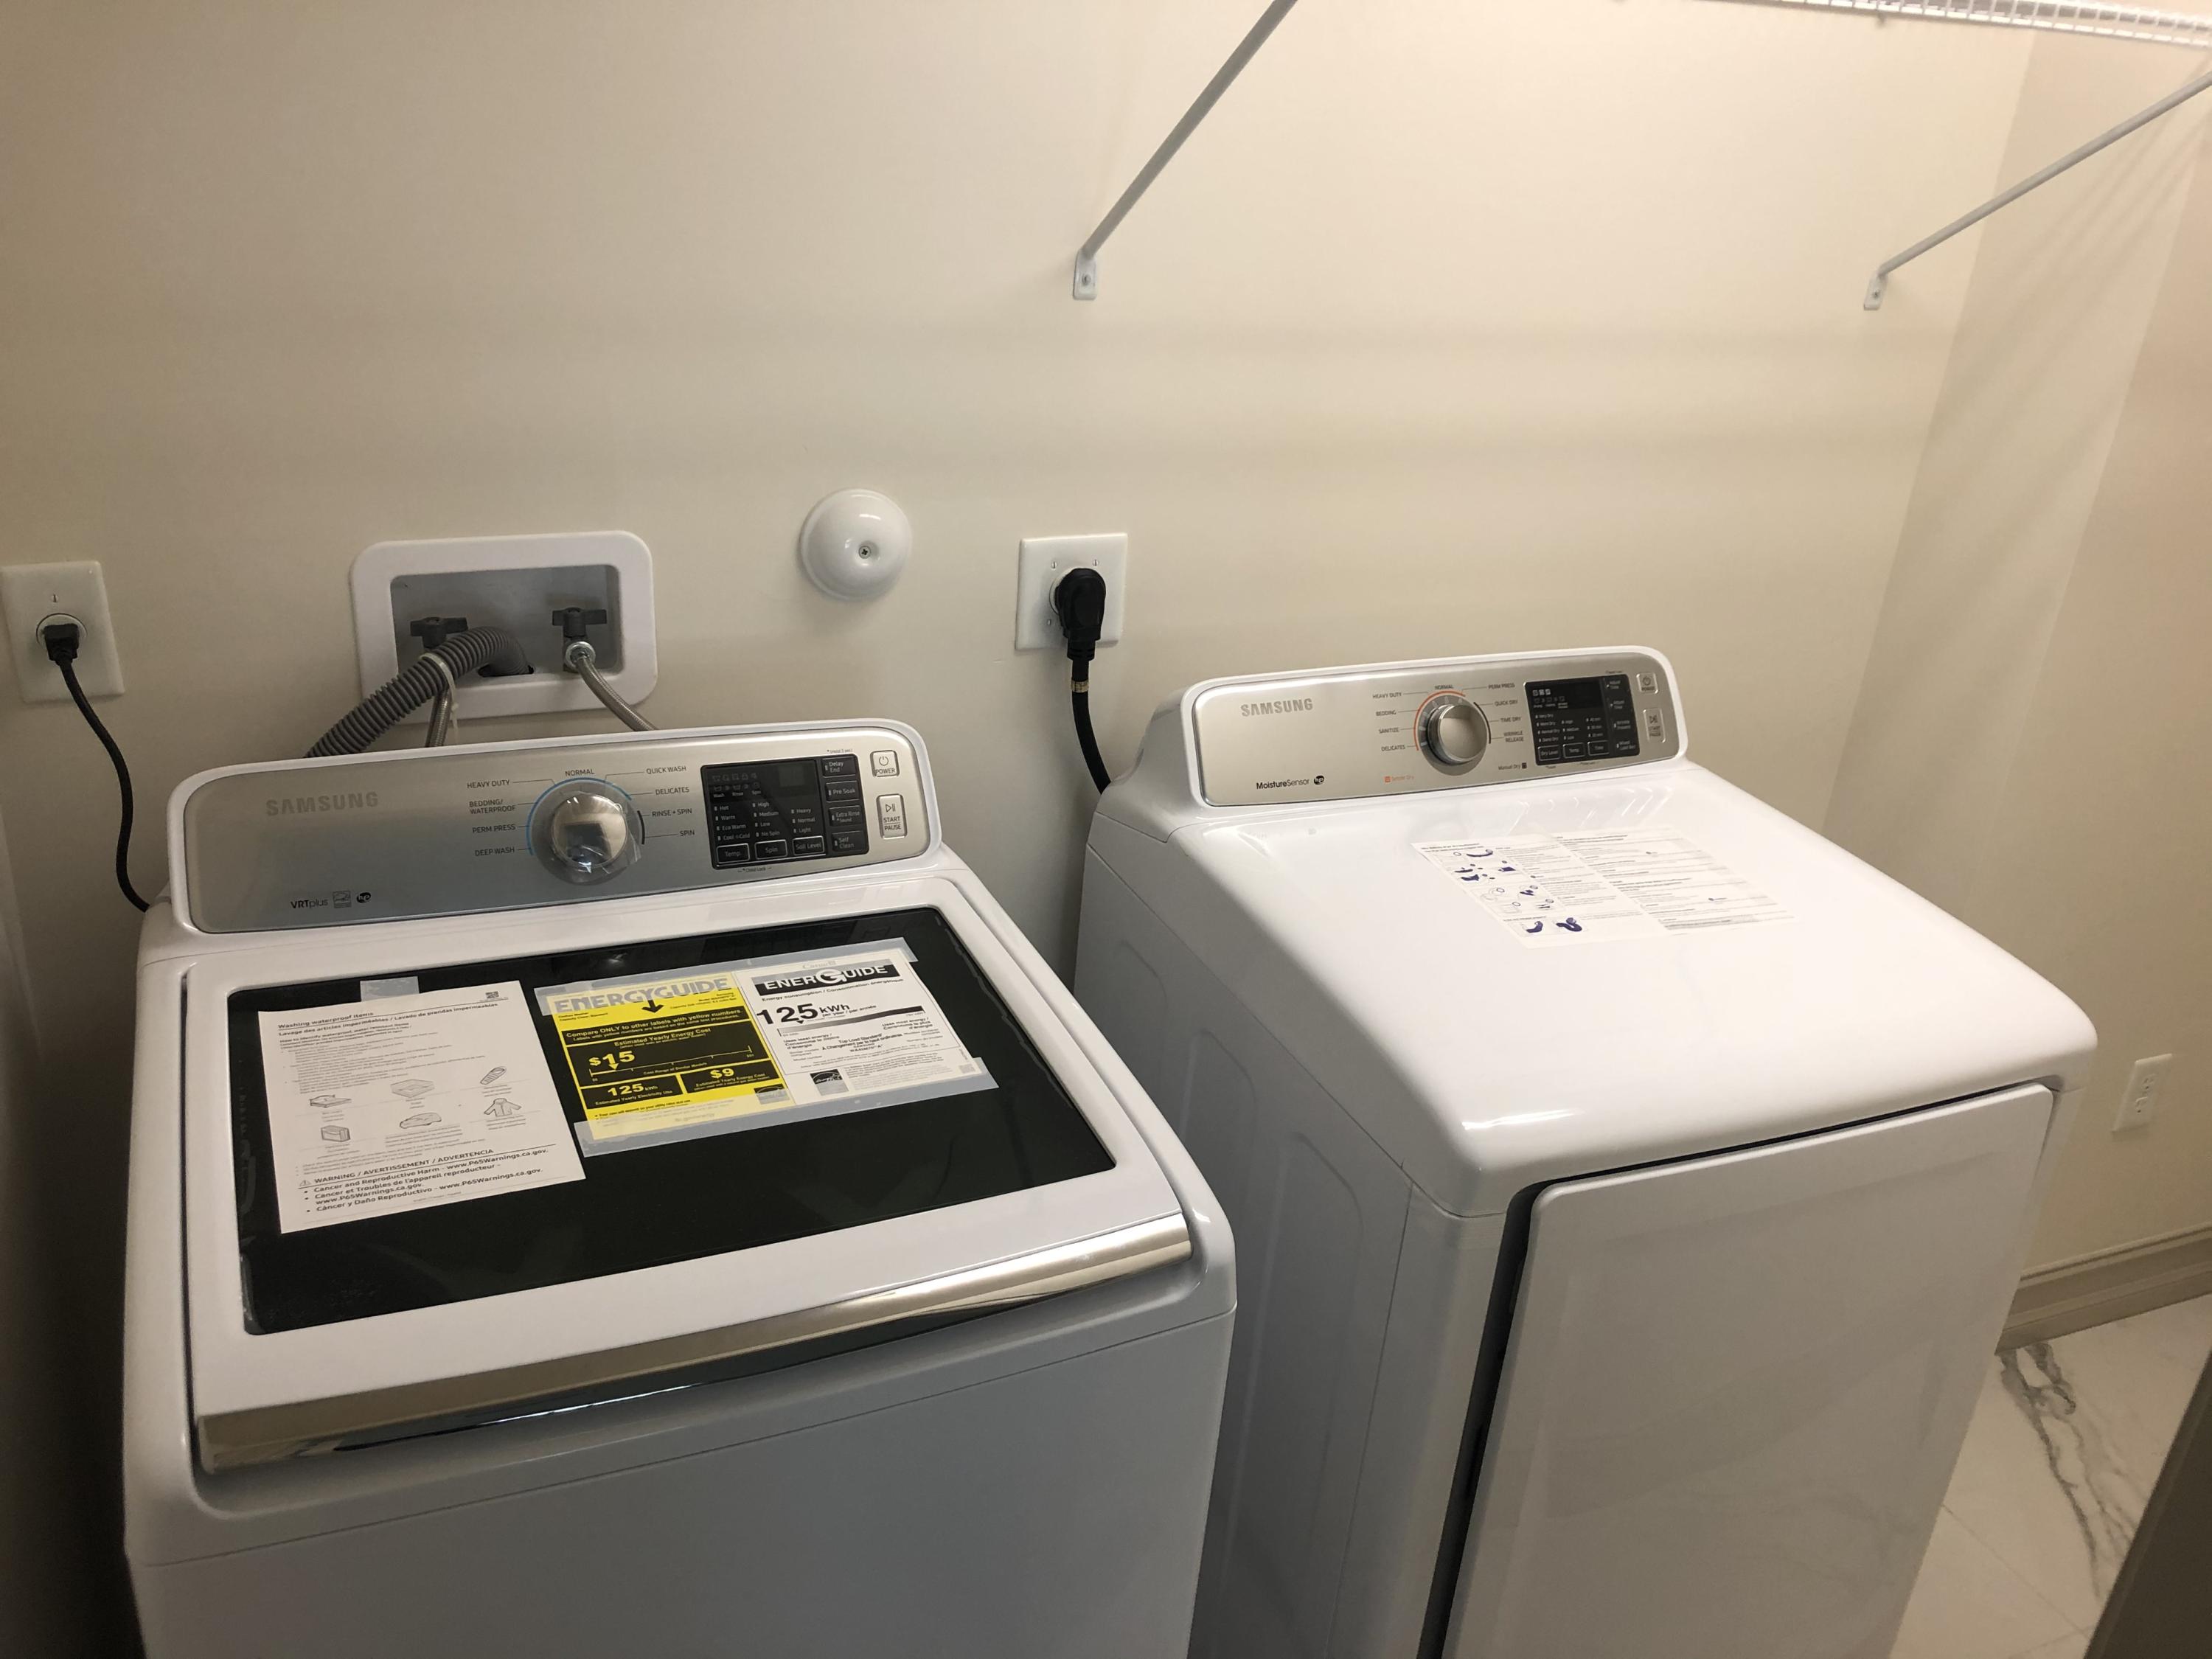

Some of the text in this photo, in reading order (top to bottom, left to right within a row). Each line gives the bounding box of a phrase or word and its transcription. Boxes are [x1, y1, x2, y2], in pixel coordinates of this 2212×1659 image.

[1240, 698, 1313, 717] SAMSUNG
[565, 768, 595, 776] NORMAL
[655, 786, 690, 796] DELICATES
[1256, 778, 1310, 790] MoistureSensor
[265, 791, 378, 816] SAMSUNG
[469, 799, 504, 807] BEDDING/
[470, 805, 516, 815] WATERPROOF
[475, 846, 515, 856] DEEP WASH
[291, 898, 329, 909] VRTplus
[763, 965, 888, 991] ENERGUIDE
[554, 978, 731, 1013] ENERGYGUIDE
[278, 1021, 310, 1029] Washing
[311, 1015, 352, 1025] waterproof
[757, 1003, 850, 1025] 125 kWh
[566, 1029, 599, 1038] Compare
[711, 1009, 744, 1017] numbers.
[614, 1037, 648, 1046] Estimated
[648, 1034, 670, 1042] Yearly
[671, 1030, 695, 1039] Energy
[588, 1050, 636, 1067] $15
[709, 1068, 734, 1079] $9
[608, 1082, 644, 1096] 125
[313, 1184, 343, 1193] Cancer
[361, 1172, 416, 1185] Reproductive
[417, 1166, 440, 1175] Harm
[446, 1149, 549, 1170] www.P65Warnings.ca.gov.
[314, 1172, 355, 1184] WARNING
[364, 1159, 431, 1175] AVERTISSEMENT
[437, 1149, 495, 1163] ADVERTENCIA
[314, 1190, 344, 1200] Cancer
[355, 1182, 392, 1192] Troubles
[404, 1172, 442, 1184] l'appareil
[443, 1164, 495, 1178] reproducteur
[316, 1202, 346, 1211] Cáncer
[354, 1197, 376, 1206] Daño
[378, 1187, 433, 1202] Reproductivo
[439, 1167, 543, 1190] www.P65Warnings.ca.gov.
[316, 1183, 424, 1206] www.P65Warnings.ca.gov.
